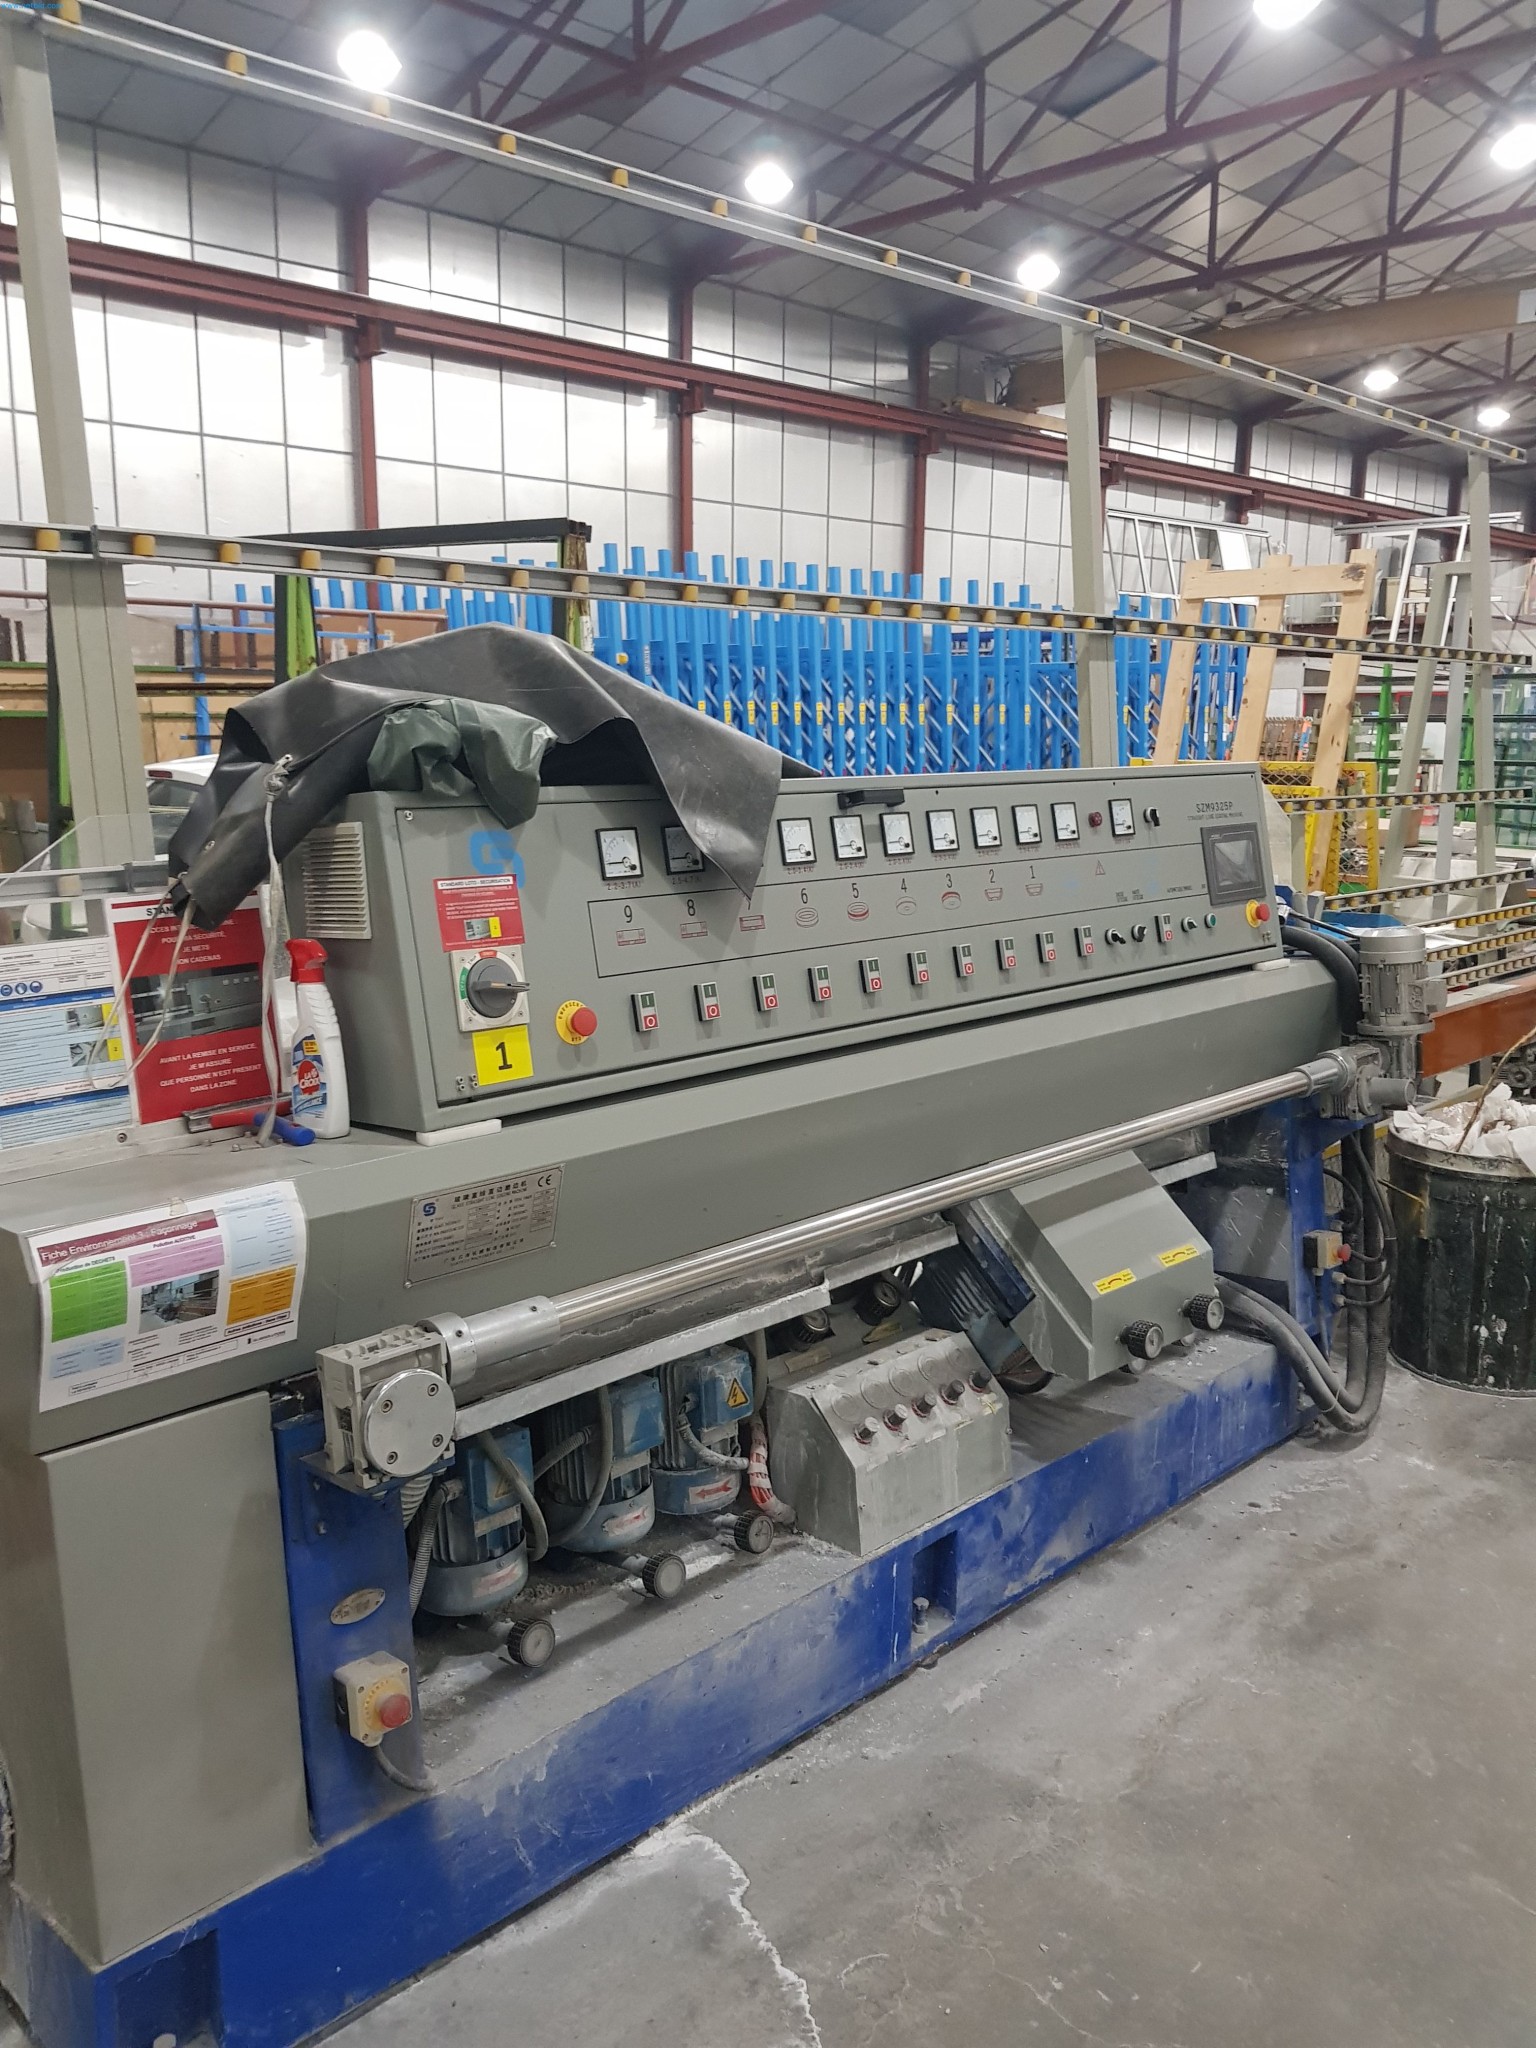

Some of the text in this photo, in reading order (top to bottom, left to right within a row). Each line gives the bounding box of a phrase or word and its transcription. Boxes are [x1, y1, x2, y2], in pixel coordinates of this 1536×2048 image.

[989, 868, 996, 884] 2
[1029, 865, 1036, 879] 1
[900, 878, 908, 893] 4
[945, 873, 953, 889] 3
[800, 887, 809, 904] 6
[851, 882, 860, 899] 5
[623, 904, 633, 923] 9
[686, 899, 696, 917] 8
[495, 1041, 513, 1071] 1
[160, 1078, 175, 1087] QUE
[175, 1072, 213, 1084] PERSONNE
[189, 1083, 209, 1093] DANS
[218, 1078, 237, 1088] ZONE
[41, 1249, 69, 1261] Fiche
[68, 1232, 137, 1255] Environnement
[150, 1221, 198, 1237] Façonnage
